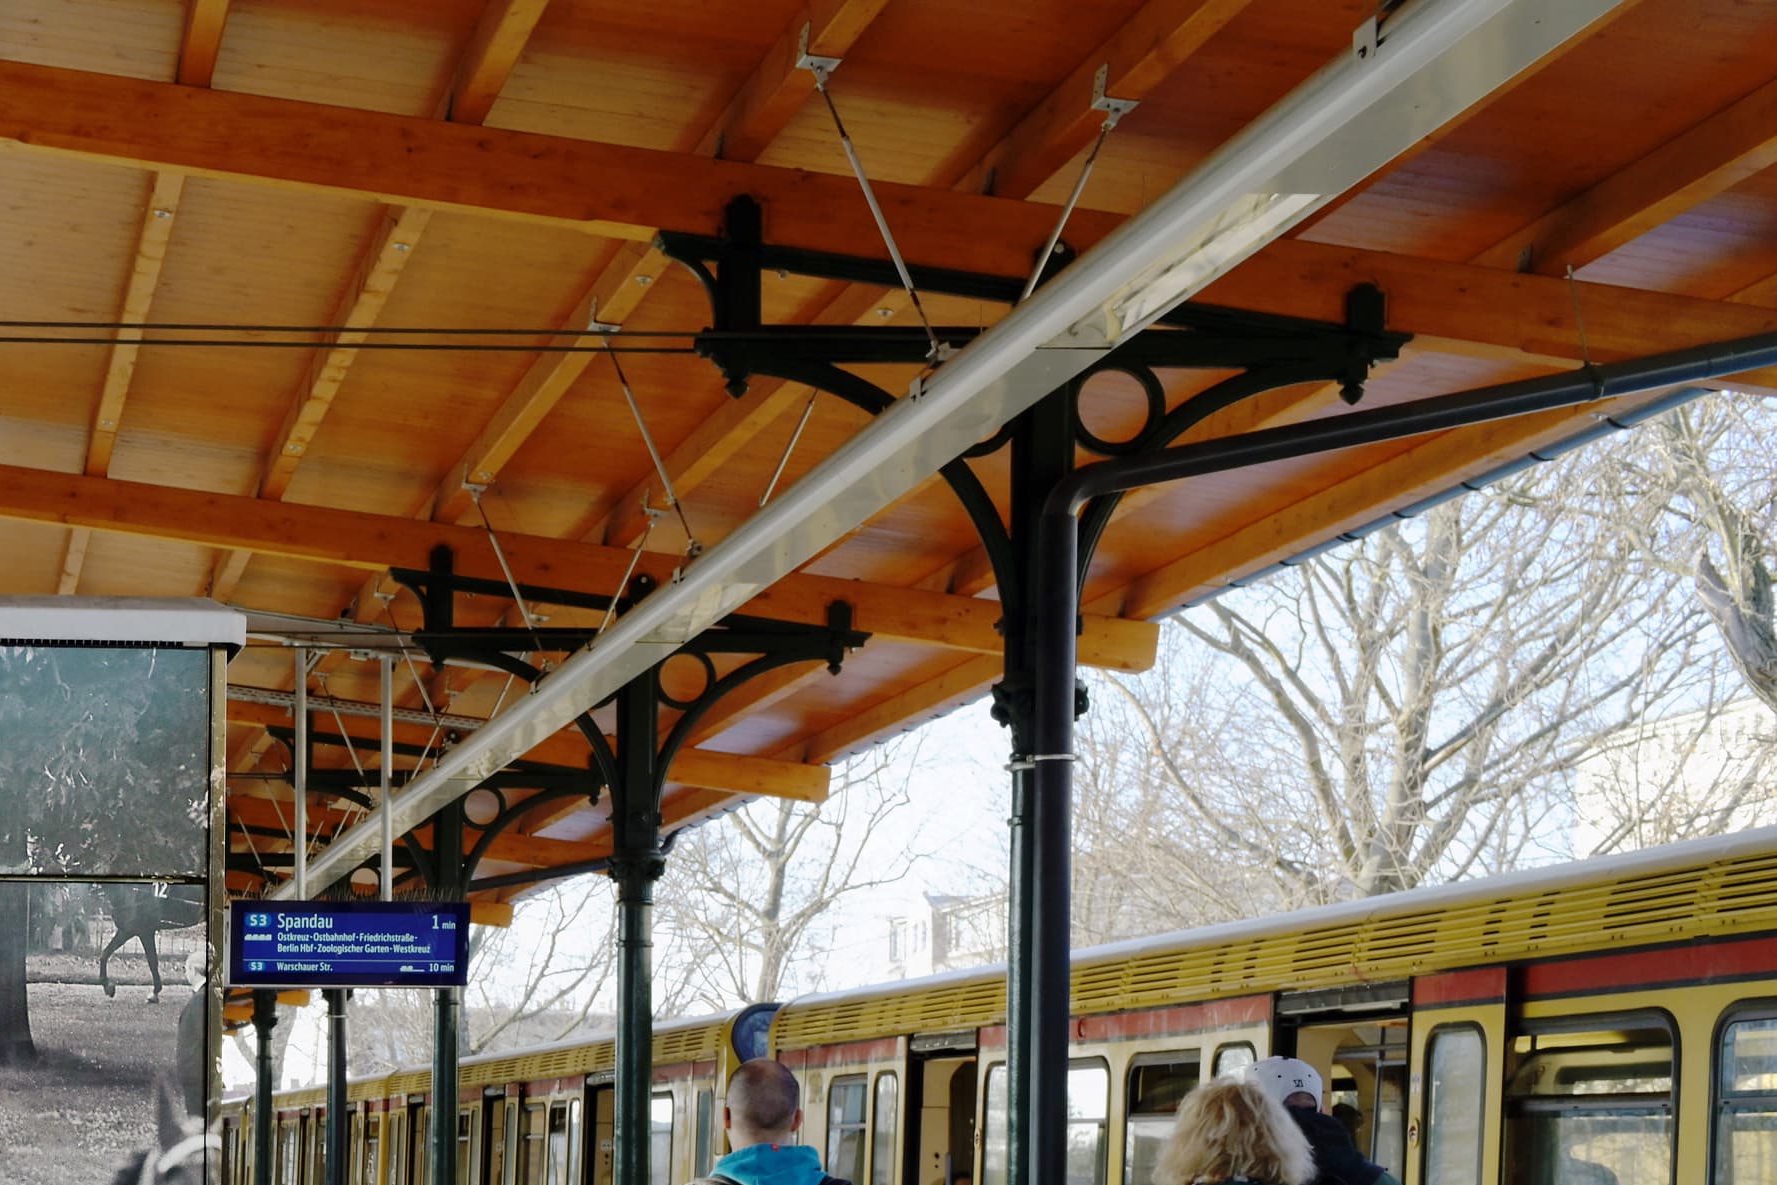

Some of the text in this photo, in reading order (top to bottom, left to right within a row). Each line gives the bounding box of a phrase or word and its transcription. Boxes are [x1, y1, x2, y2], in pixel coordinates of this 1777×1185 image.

[250, 913, 456, 932] S3 Spandau 1 min
[277, 943, 299, 953] Berlin
[317, 944, 363, 955] Zoologischer
[250, 961, 455, 973] S3 Warschauer Str. 10 min
